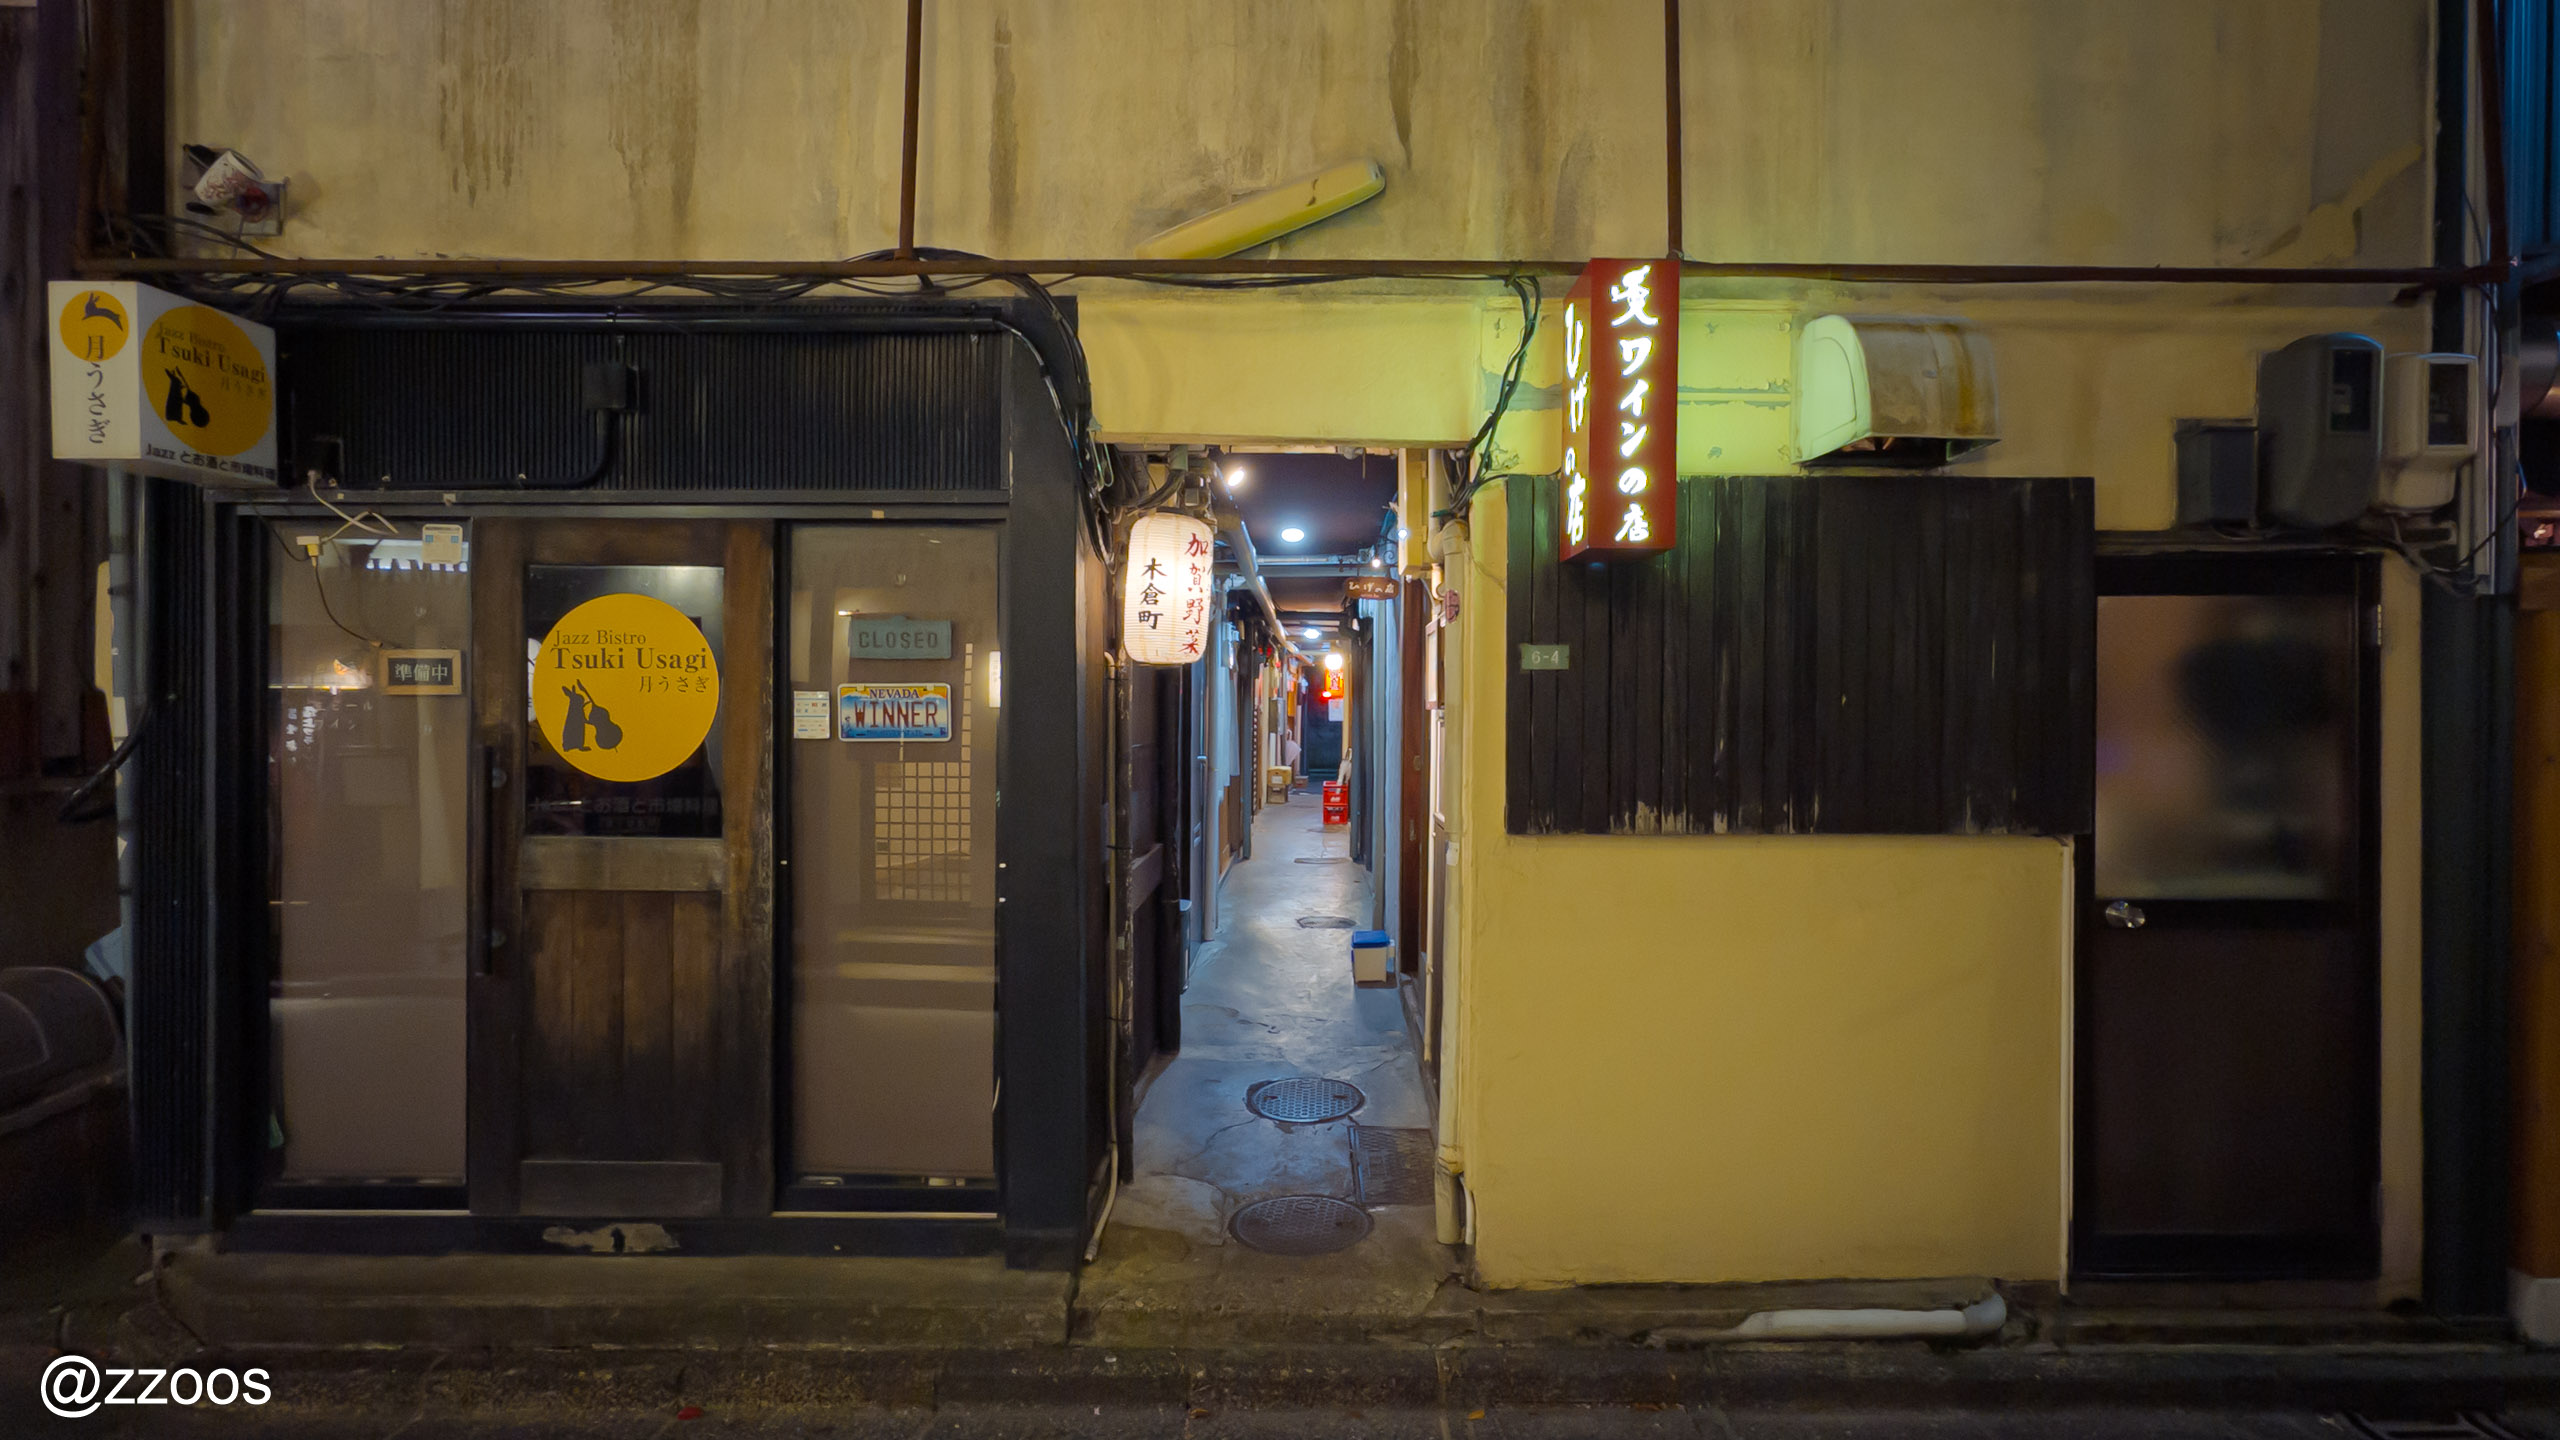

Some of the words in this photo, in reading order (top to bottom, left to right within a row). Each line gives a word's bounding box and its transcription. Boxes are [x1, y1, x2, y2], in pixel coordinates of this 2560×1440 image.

[159, 336, 211, 368] Tsuki
[217, 353, 266, 385] Usagi
[86, 335, 111, 444] 月うさぎ
[1564, 303, 1590, 546] ひげの店
[146, 443, 177, 460] Jazz
[1138, 557, 1168, 630] 木倉町
[1178, 532, 1210, 656] 加賀野菜
[553, 630, 590, 647] Jazz
[596, 629, 647, 645] Bistro
[858, 631, 939, 650] CLOSED
[550, 647, 625, 670] Tsuki
[635, 647, 708, 673] Usagi
[1531, 650, 1559, 665] 6-4
[394, 663, 448, 682] 準備中
[639, 675, 710, 694] 月うさぎ
[869, 688, 920, 699] NEVADA
[854, 700, 939, 729] WINNER
